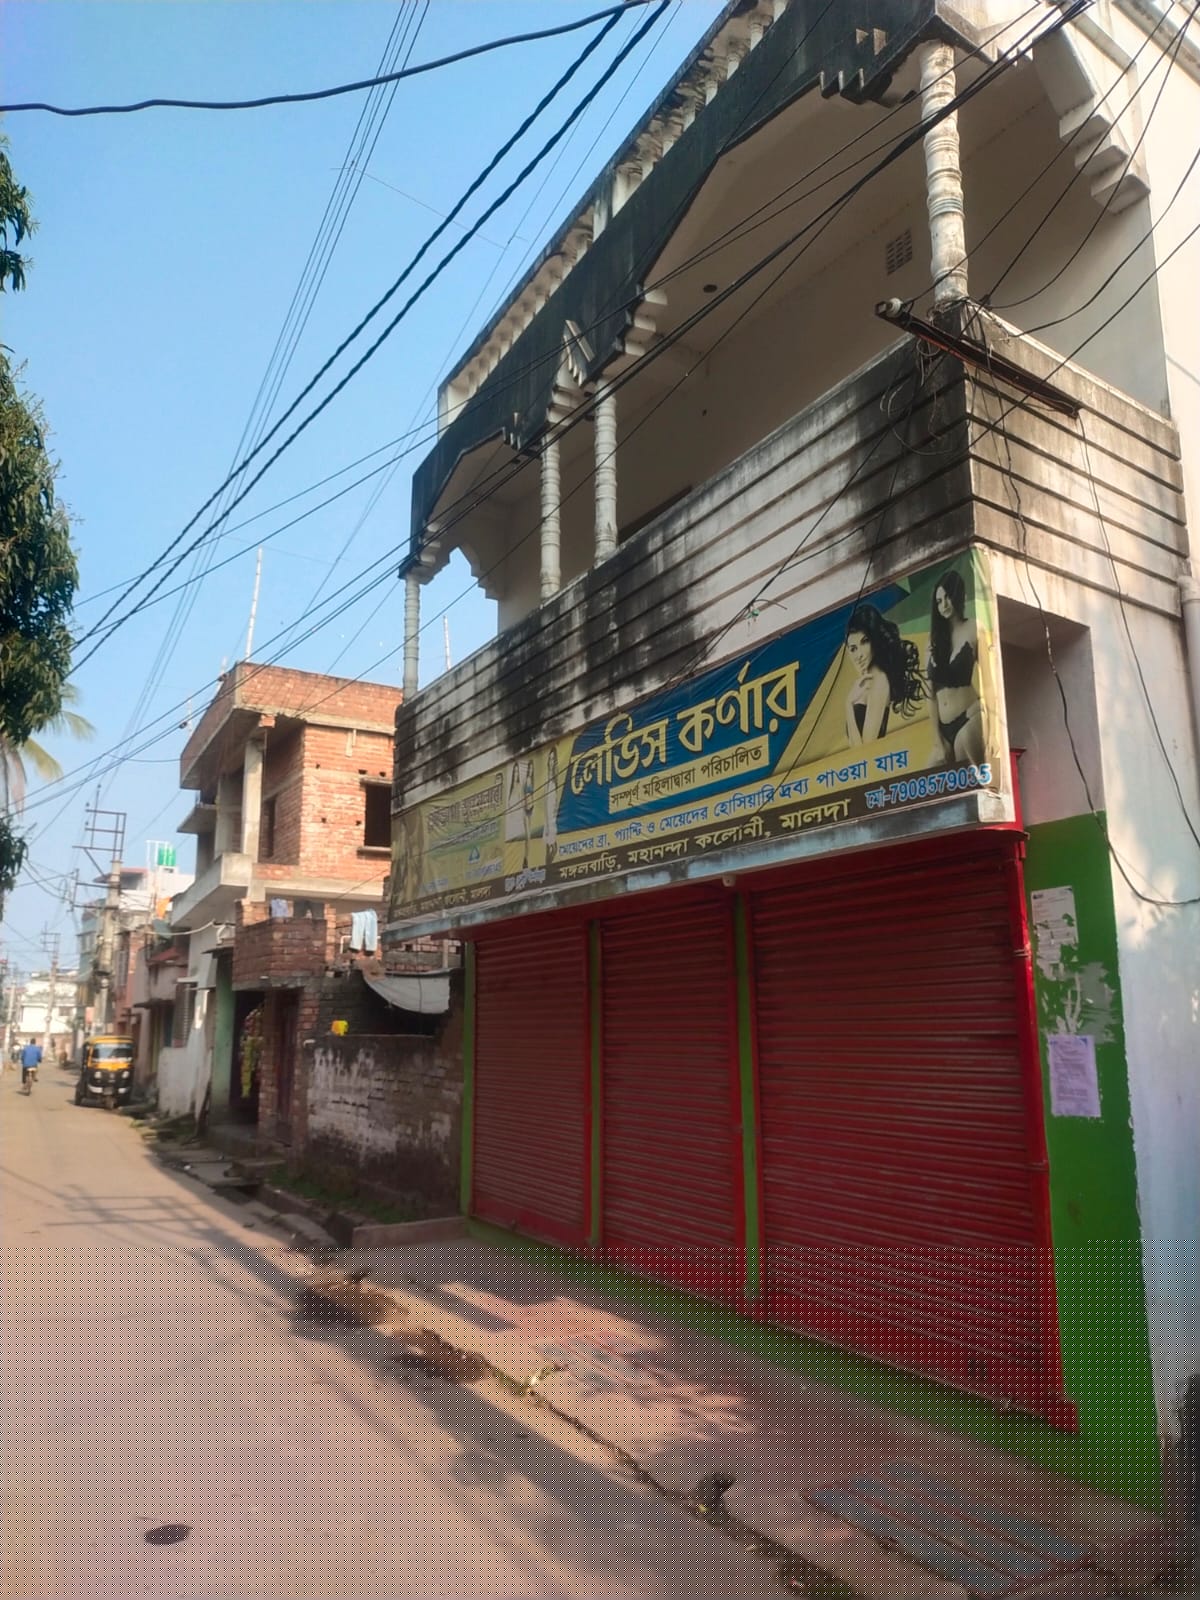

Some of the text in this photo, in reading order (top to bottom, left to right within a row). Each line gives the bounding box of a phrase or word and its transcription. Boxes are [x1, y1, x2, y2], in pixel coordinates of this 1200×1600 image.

[570, 660, 800, 795] লেডিস কর্ণার
[611, 745, 763, 807] সম্পূর্ণ মহিলাদ্বারা পরিচালিত
[647, 823, 656, 833] ও
[660, 805, 709, 832] মেয়েদের
[714, 784, 776, 818] হোসিয়ারি
[779, 777, 810, 799] দ্রব্য
[816, 760, 868, 788] পাওয়া
[874, 750, 909, 772] যায়
[627, 838, 690, 863] মহানন্দা
[694, 815, 772, 849] কলোনী,
[779, 798, 852, 830] মালদা
